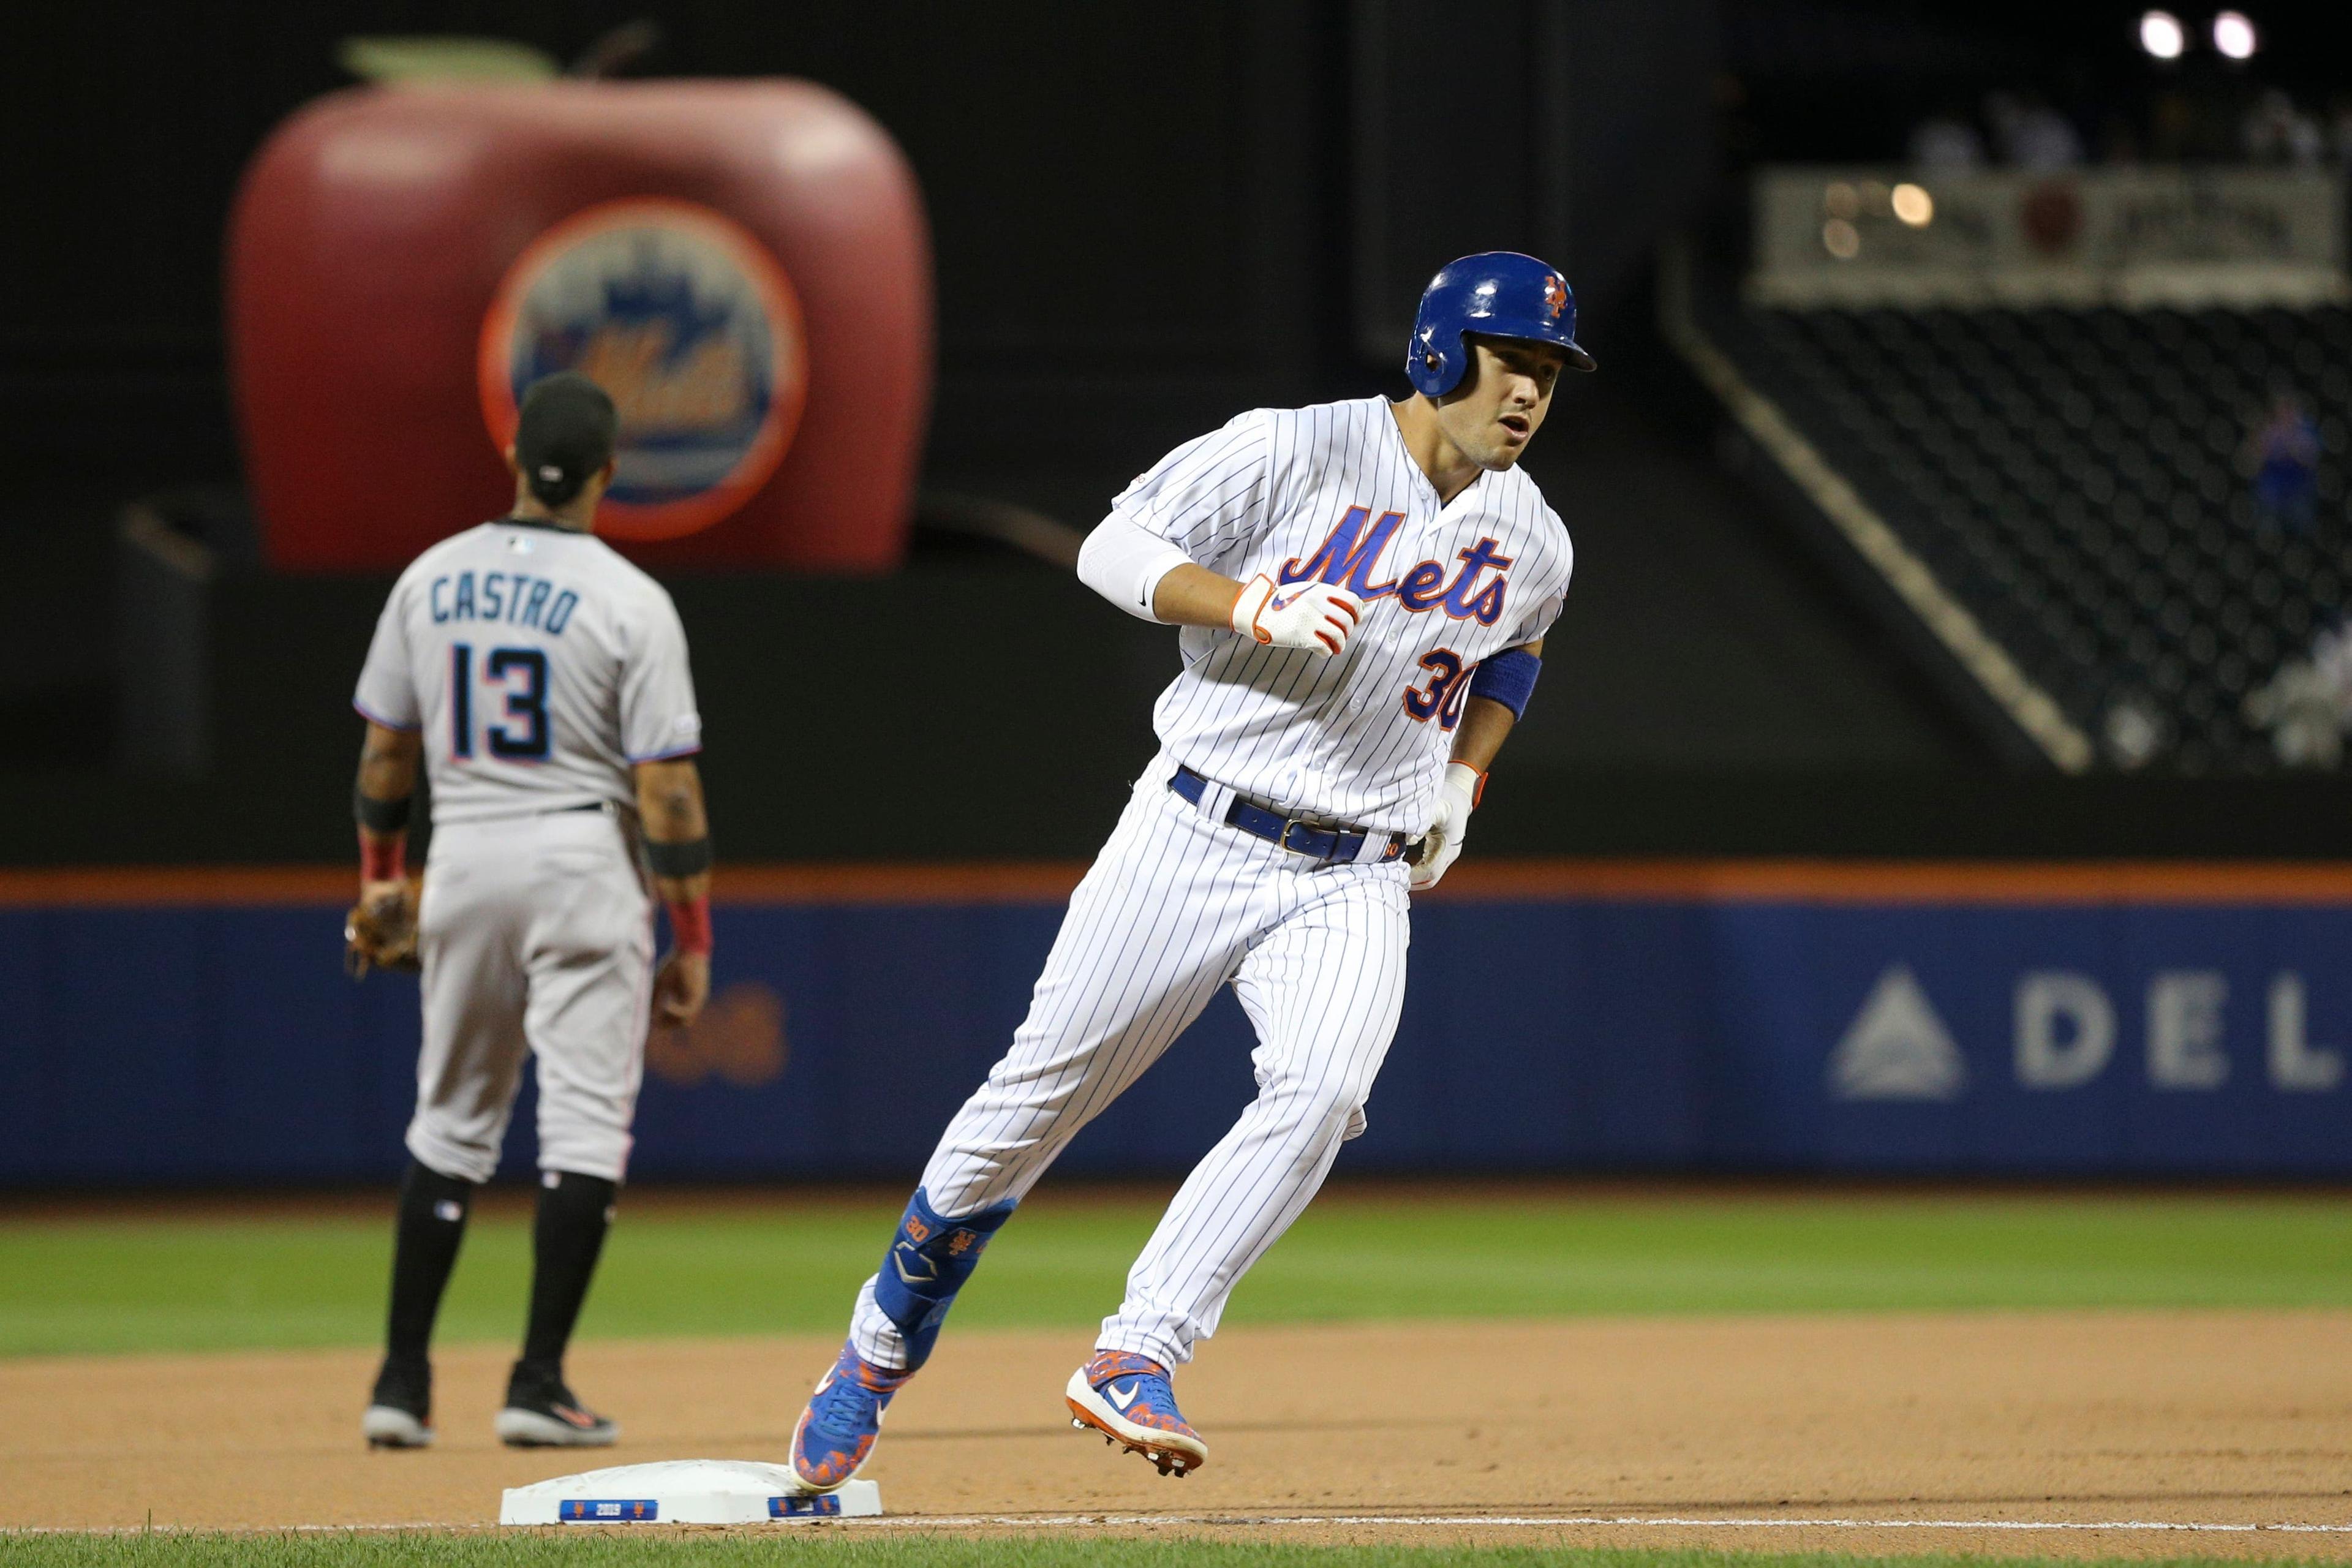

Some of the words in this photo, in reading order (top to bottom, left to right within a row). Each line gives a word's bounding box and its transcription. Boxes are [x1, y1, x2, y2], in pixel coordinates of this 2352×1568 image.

[431, 571, 579, 635] CASTRO
[1278, 505, 1513, 627] Mets
[447, 643, 551, 766] 13
[906, 1215, 930, 1242] 30
